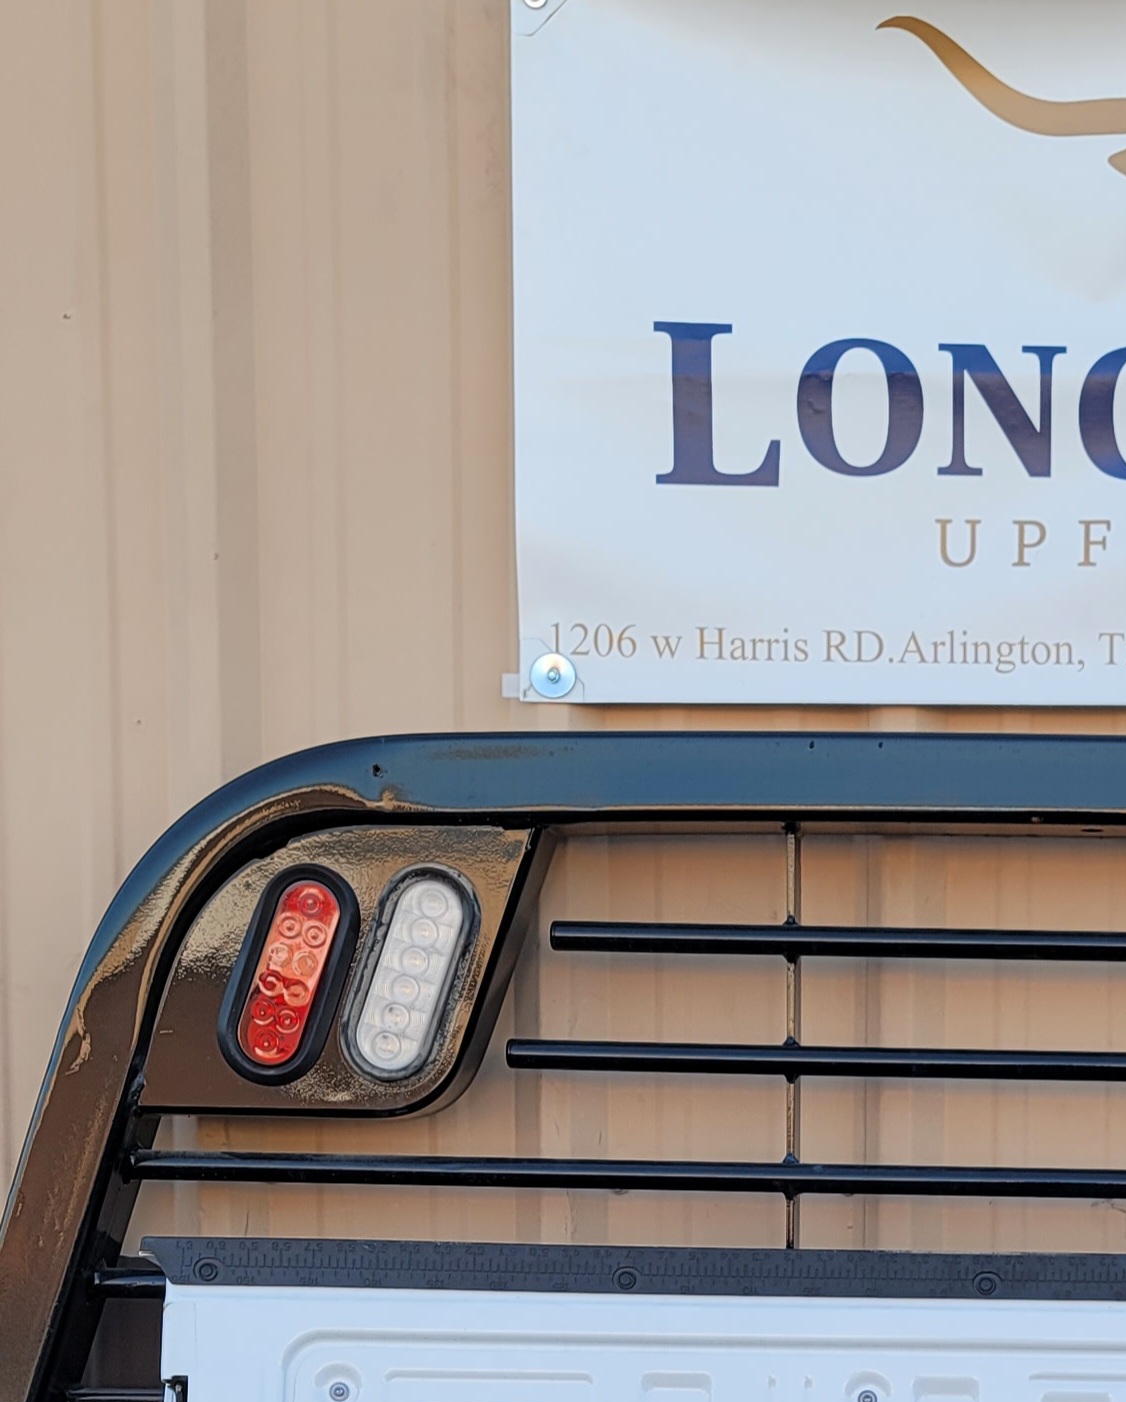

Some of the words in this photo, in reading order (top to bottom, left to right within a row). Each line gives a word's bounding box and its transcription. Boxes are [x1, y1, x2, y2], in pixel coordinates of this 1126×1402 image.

[551, 622, 638, 659] 1206
[651, 635, 683, 659] w
[694, 627, 810, 663] Harris
